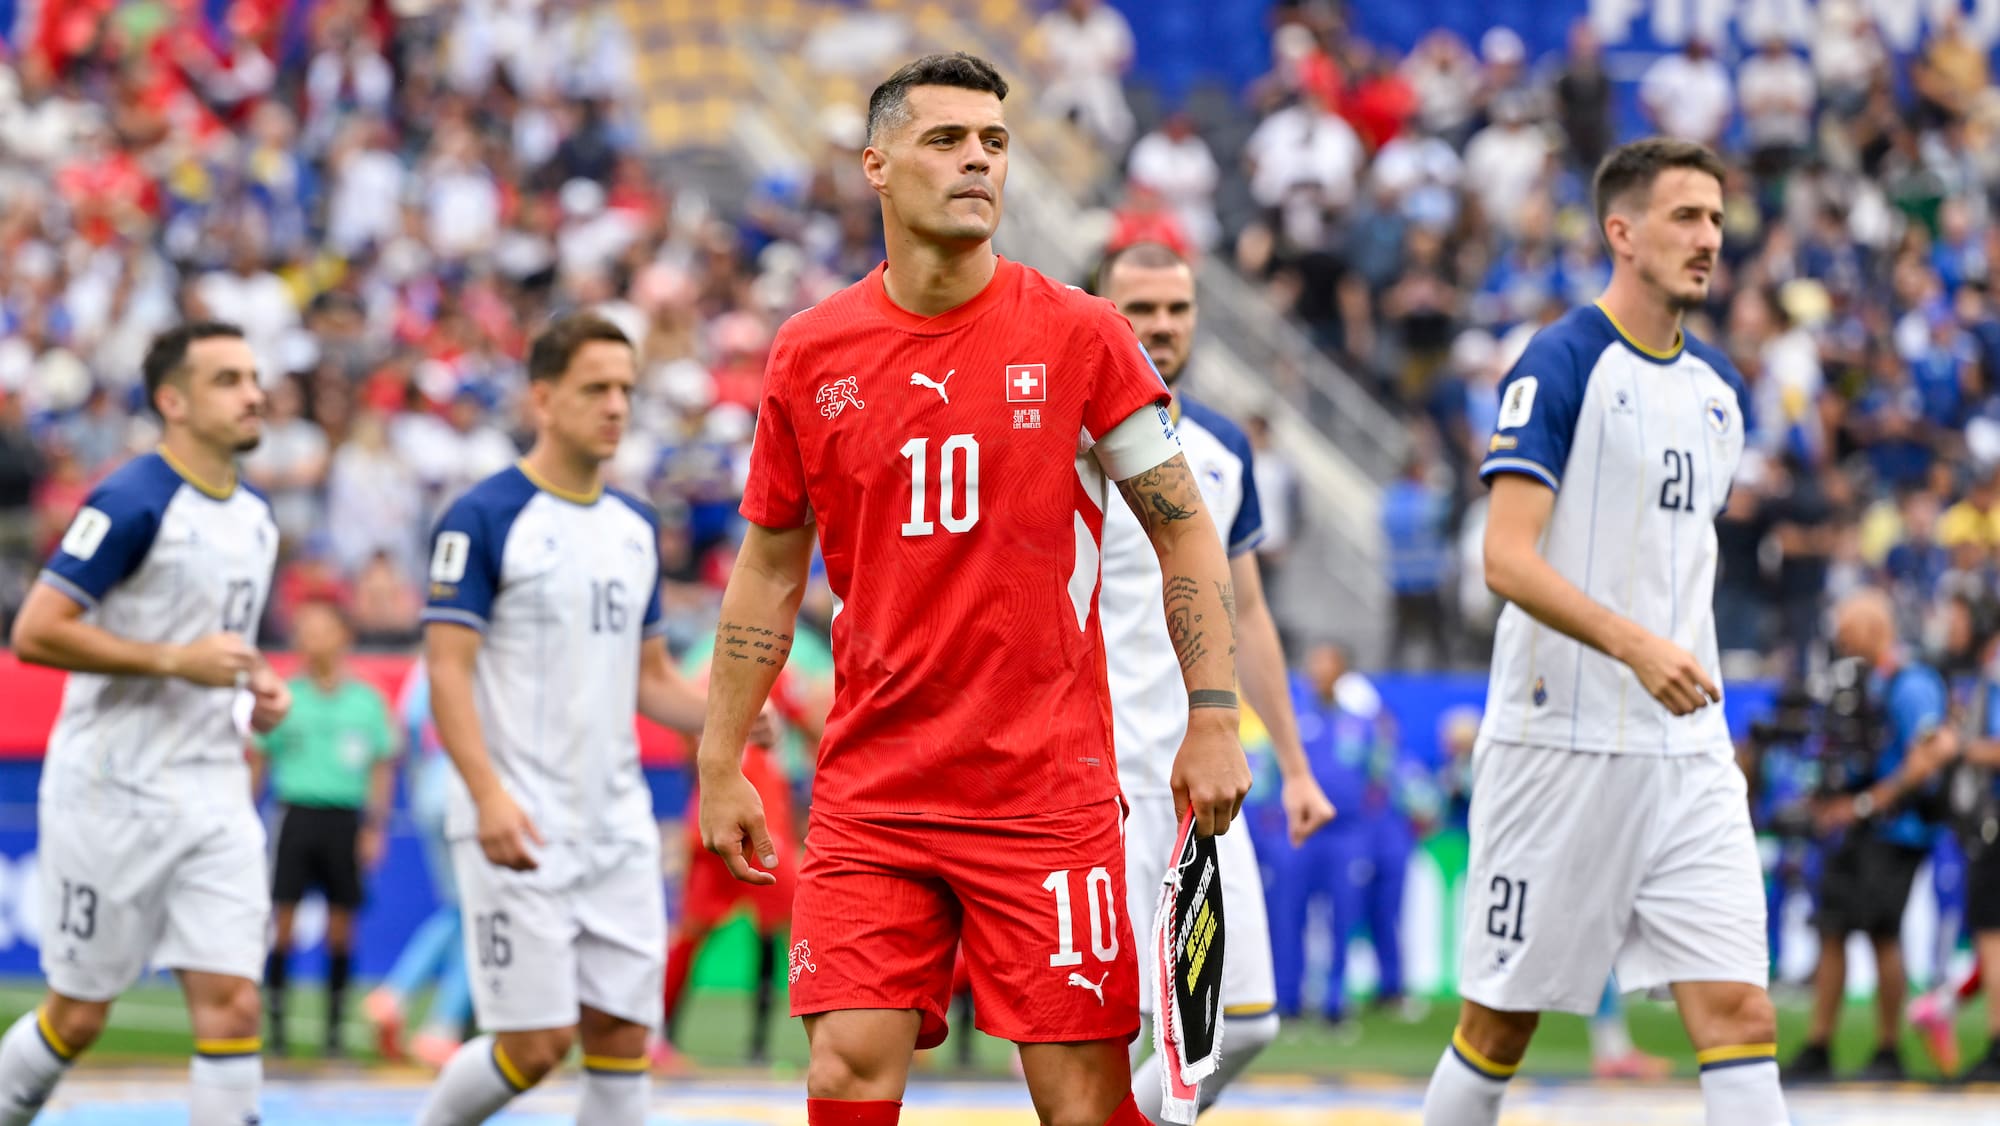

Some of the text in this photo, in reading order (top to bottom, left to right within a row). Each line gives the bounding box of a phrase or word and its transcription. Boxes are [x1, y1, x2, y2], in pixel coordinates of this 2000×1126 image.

[900, 433, 980, 537] 10
[1660, 450, 1695, 512] 21
[592, 578, 627, 634] 16
[60, 878, 98, 940] 13
[1042, 867, 1118, 966] 10
[1487, 875, 1527, 942] 21
